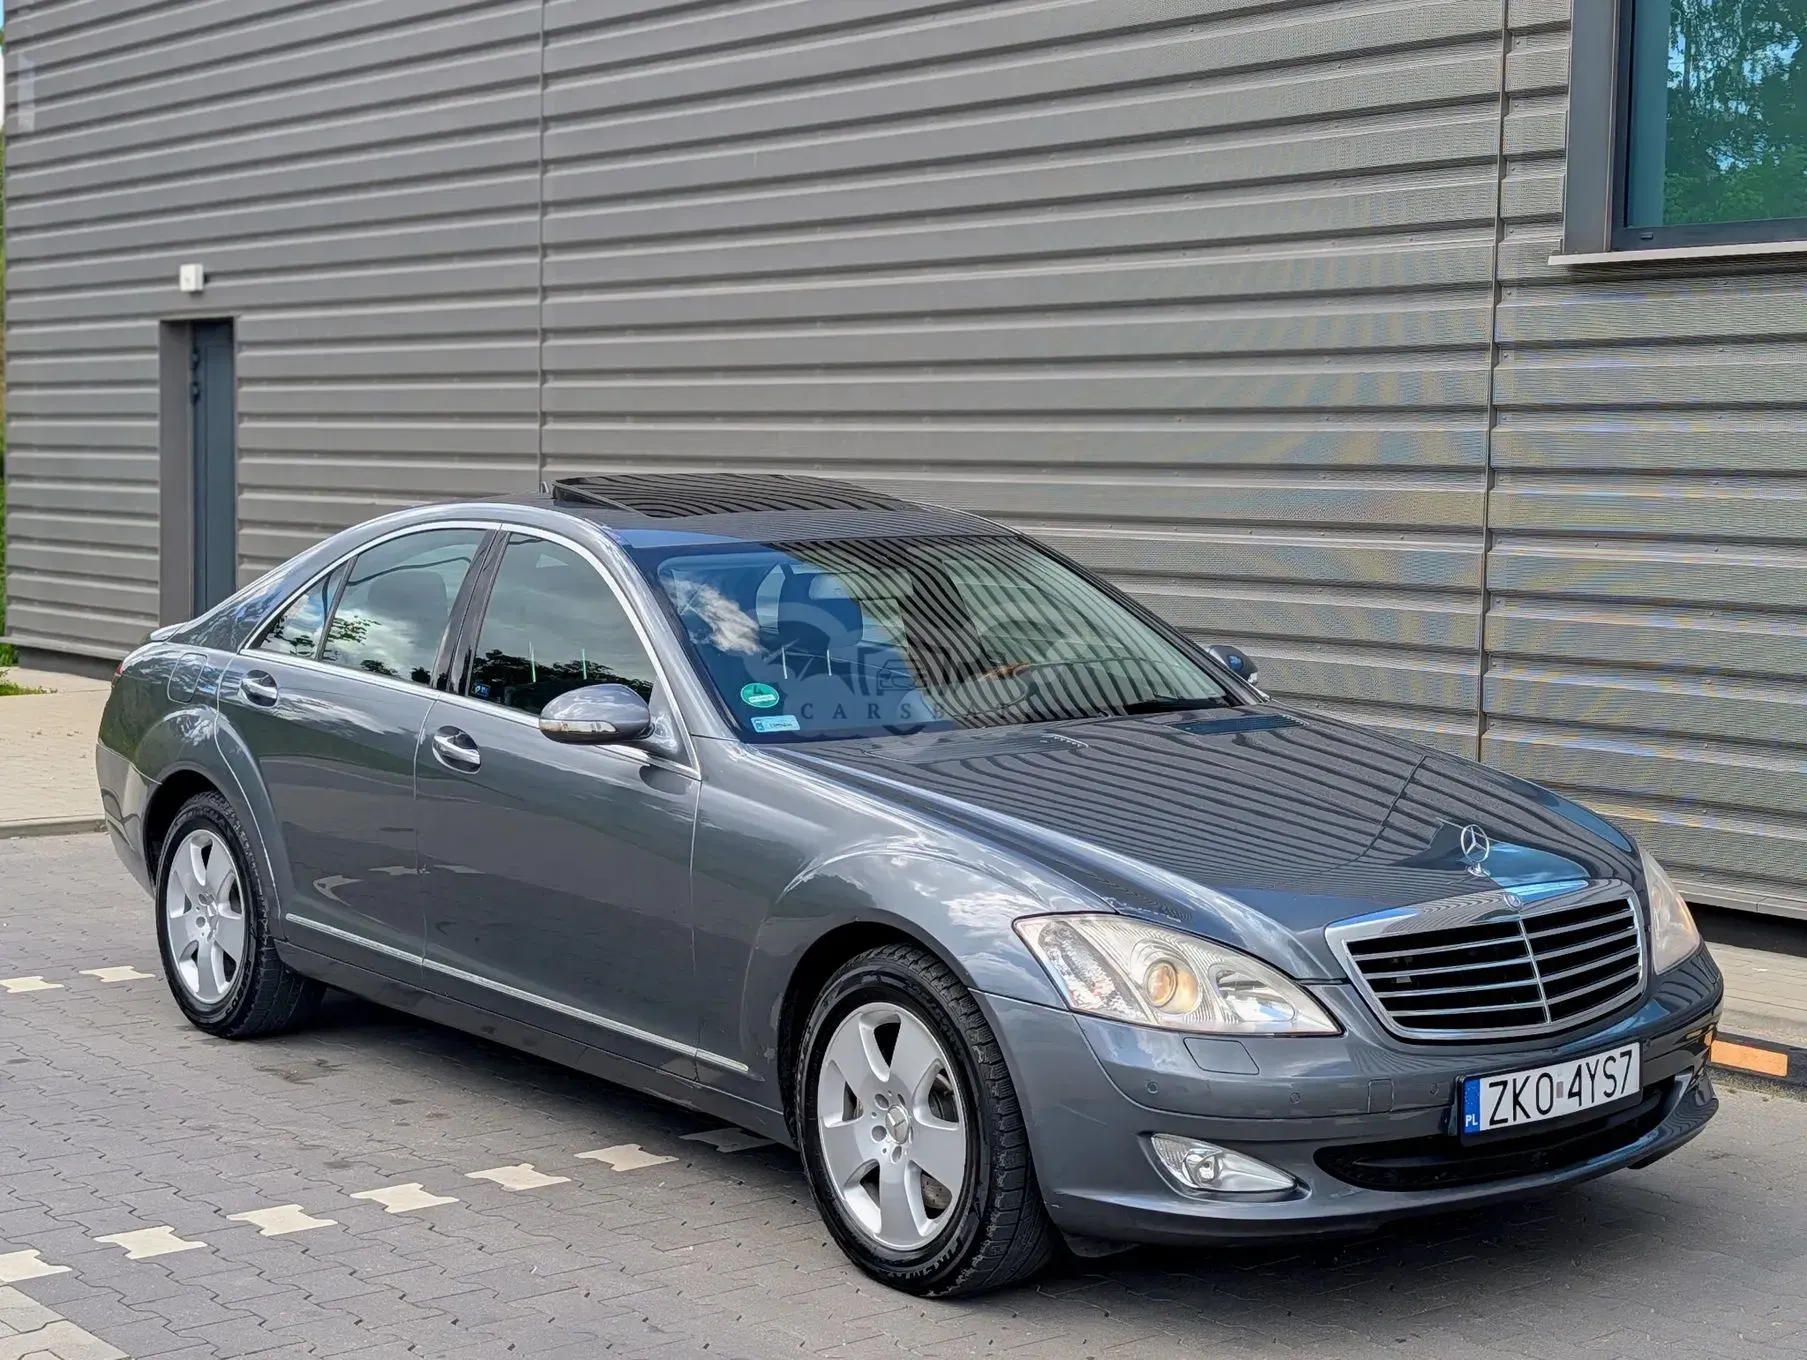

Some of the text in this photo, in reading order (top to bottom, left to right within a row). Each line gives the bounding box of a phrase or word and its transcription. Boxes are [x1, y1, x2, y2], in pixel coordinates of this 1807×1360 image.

[1488, 1049, 1633, 1126] ZKO 4YS7
[1465, 1114, 1479, 1127] PL
